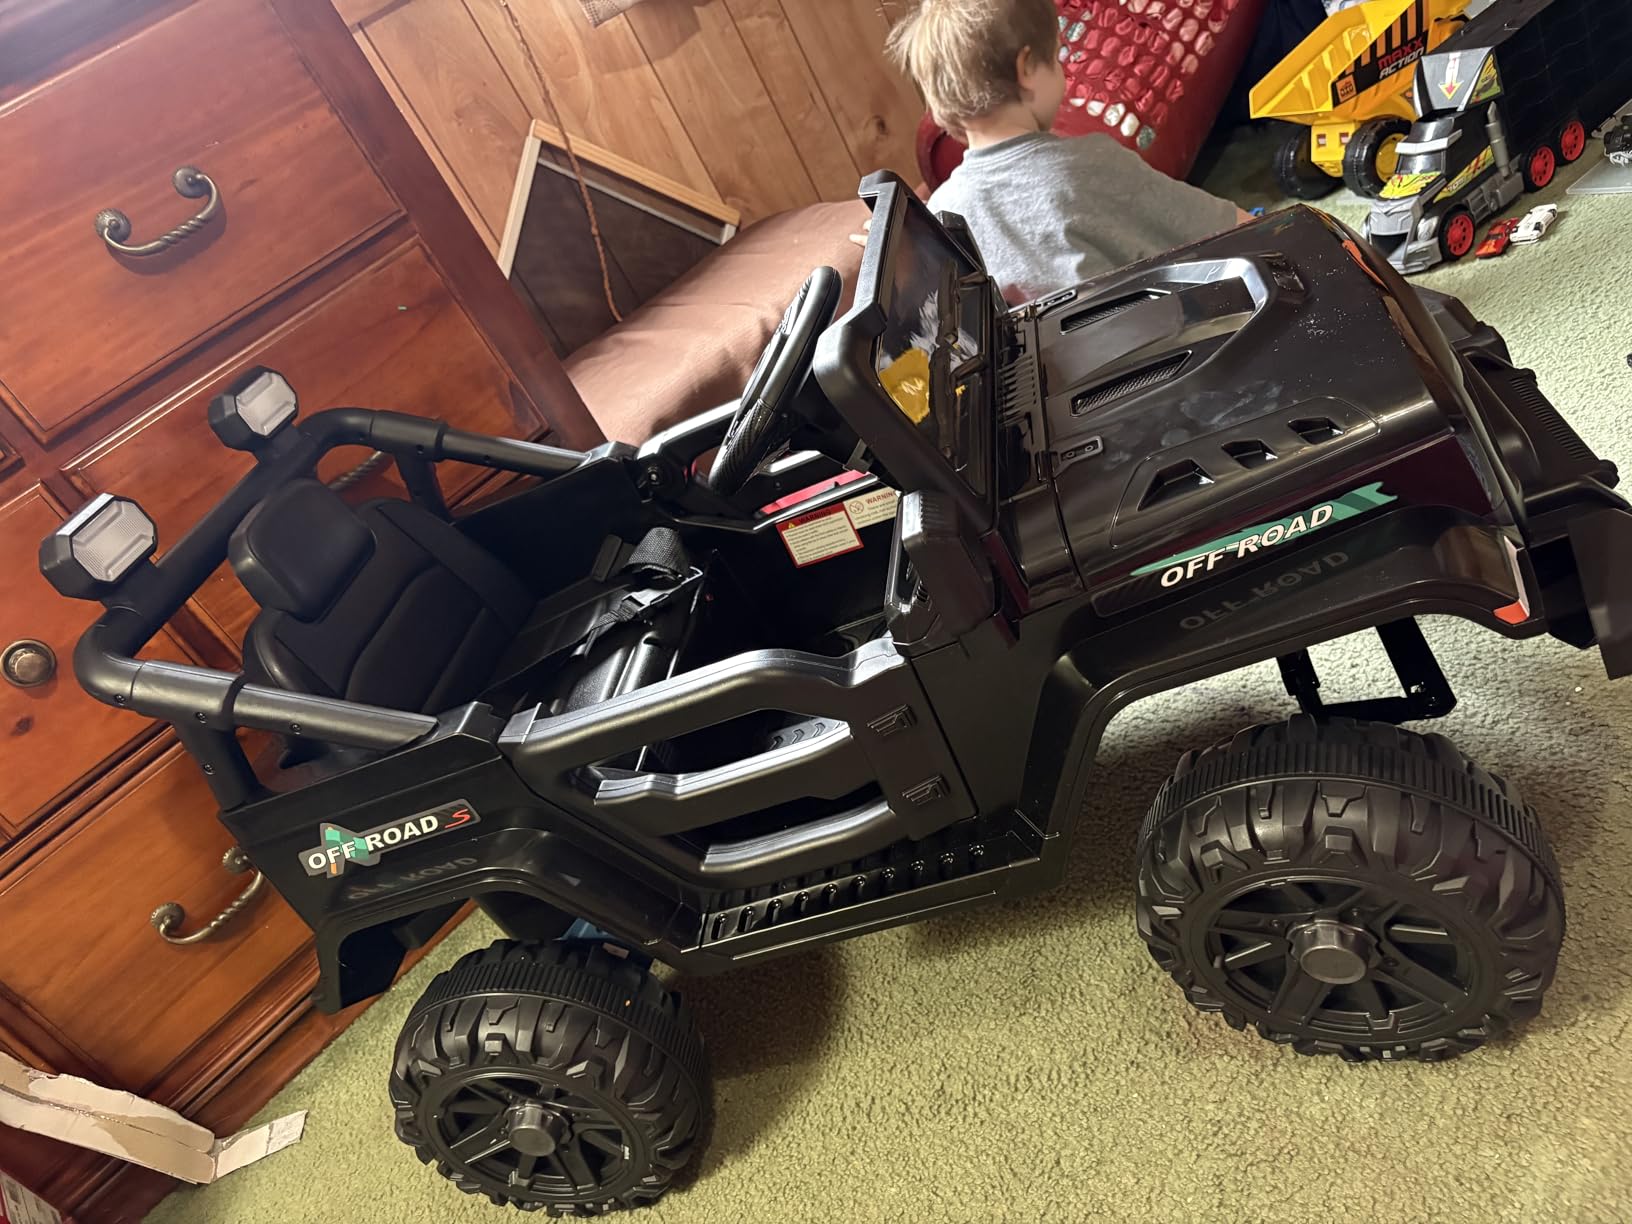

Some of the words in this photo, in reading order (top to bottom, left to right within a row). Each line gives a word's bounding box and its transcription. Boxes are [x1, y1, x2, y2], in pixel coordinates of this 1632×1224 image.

[1378, 37, 1423, 70] MAXX
[1379, 47, 1424, 79] ACTION
[1160, 547, 1226, 588] OFF
[1237, 504, 1334, 559] ROAD
[308, 841, 356, 870] OFF
[364, 815, 439, 851] ROAD
[444, 808, 472, 829] S
